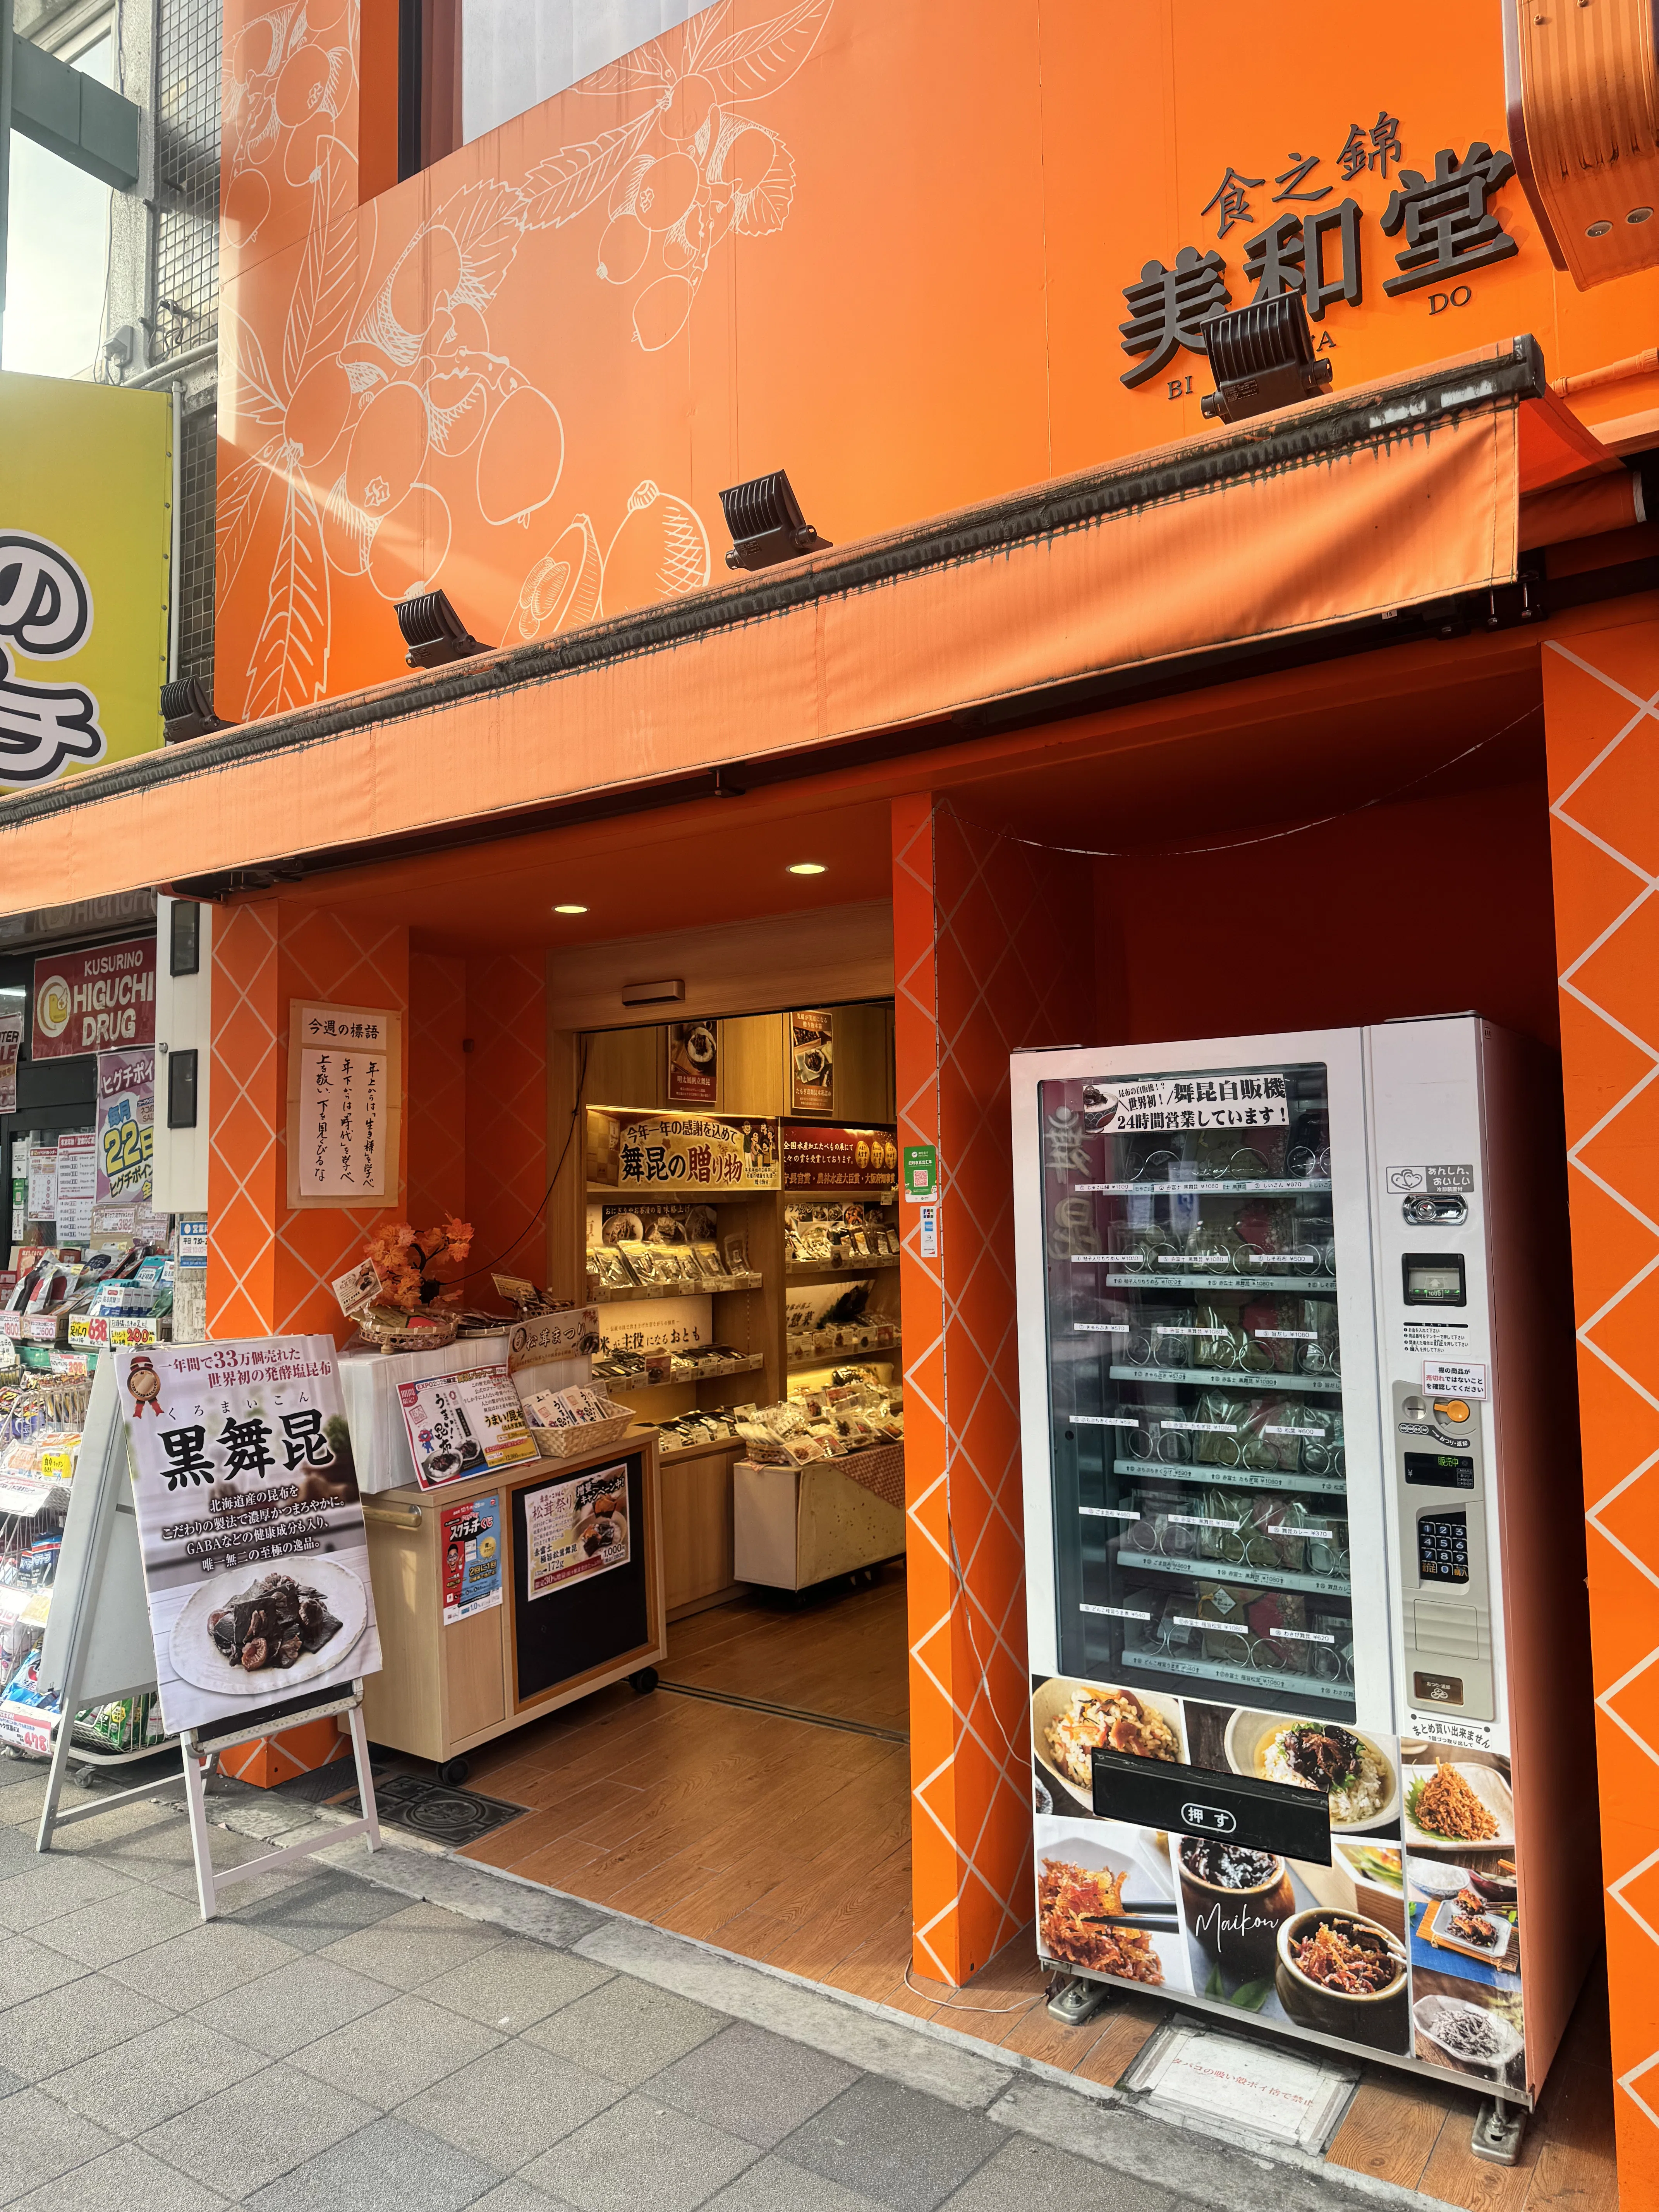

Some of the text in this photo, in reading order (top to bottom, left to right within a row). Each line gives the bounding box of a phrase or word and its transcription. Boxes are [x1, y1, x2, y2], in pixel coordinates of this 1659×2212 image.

[1201, 111, 1403, 238] 食之錦
[1118, 141, 1519, 389] 美和堂
[1166, 285, 1471, 400] BI DO
[84, 950, 143, 977] KUSURINO
[73, 971, 154, 1014] HIGUCHI
[82, 1009, 136, 1046] DRUG
[309, 1018, 380, 1039] 今週の標語
[1128, 1095, 1163, 1111] 世界初!
[1174, 1078, 1285, 1104] 舞昆自販機
[108, 1099, 130, 1127] 毎月
[1118, 1106, 1285, 1130] 24時間営業しています!
[627, 1120, 738, 1144] 今年一年の感謝を込めて
[784, 1141, 854, 1151] 全国水産加工たべもの展にて
[620, 1144, 743, 1184] 舞昆の贈り物
[1428, 1166, 1470, 1175] あんしん、
[1433, 1177, 1470, 1185] おいしい
[605, 1204, 691, 1215] おにぎりやお茶漬の旨味格上げ
[526, 1321, 586, 1351] 松茸まつり
[158, 1347, 301, 1374] 一年間で33万個売れた
[207, 1362, 331, 1389] 世界初の発酵塩昆布
[417, 1377, 457, 1389] EXPO2025限定
[1426, 1375, 1483, 1384] 売切れではないこと
[1426, 1384, 1484, 1393] を確認してください
[169, 1391, 309, 1420] くろまいこん
[157, 1408, 334, 1491] 黒舞昆
[1439, 1436, 1468, 1447] おつり・返却
[1438, 1456, 1459, 1467] 販売中
[210, 1484, 298, 1513] 北海道産の昆布を
[580, 1477, 625, 1505] キャンペーン中!
[162, 1496, 345, 1540] こだわりの製法で濃厚かつまろやかに。
[532, 1494, 572, 1521] 松茸祭り
[187, 1516, 329, 1556] GABAなどの健康成分も入り、
[450, 1516, 493, 1541] スクラッチくじ
[202, 1540, 320, 1571] 唯一無二の至極の逸品。
[534, 1544, 553, 1557] 赤富士
[1426, 1681, 1451, 1690] おつり・返却
[1412, 1723, 1490, 1749] まとめ買い出来ません
[1428, 1735, 1474, 1748] 1個づつ取り出して
[1188, 1807, 1229, 1827] 押す
[1196, 1903, 1279, 1953] Maikon
[1172, 2058, 1314, 2107] タバコの吸い殻ポイ捨て禁止
